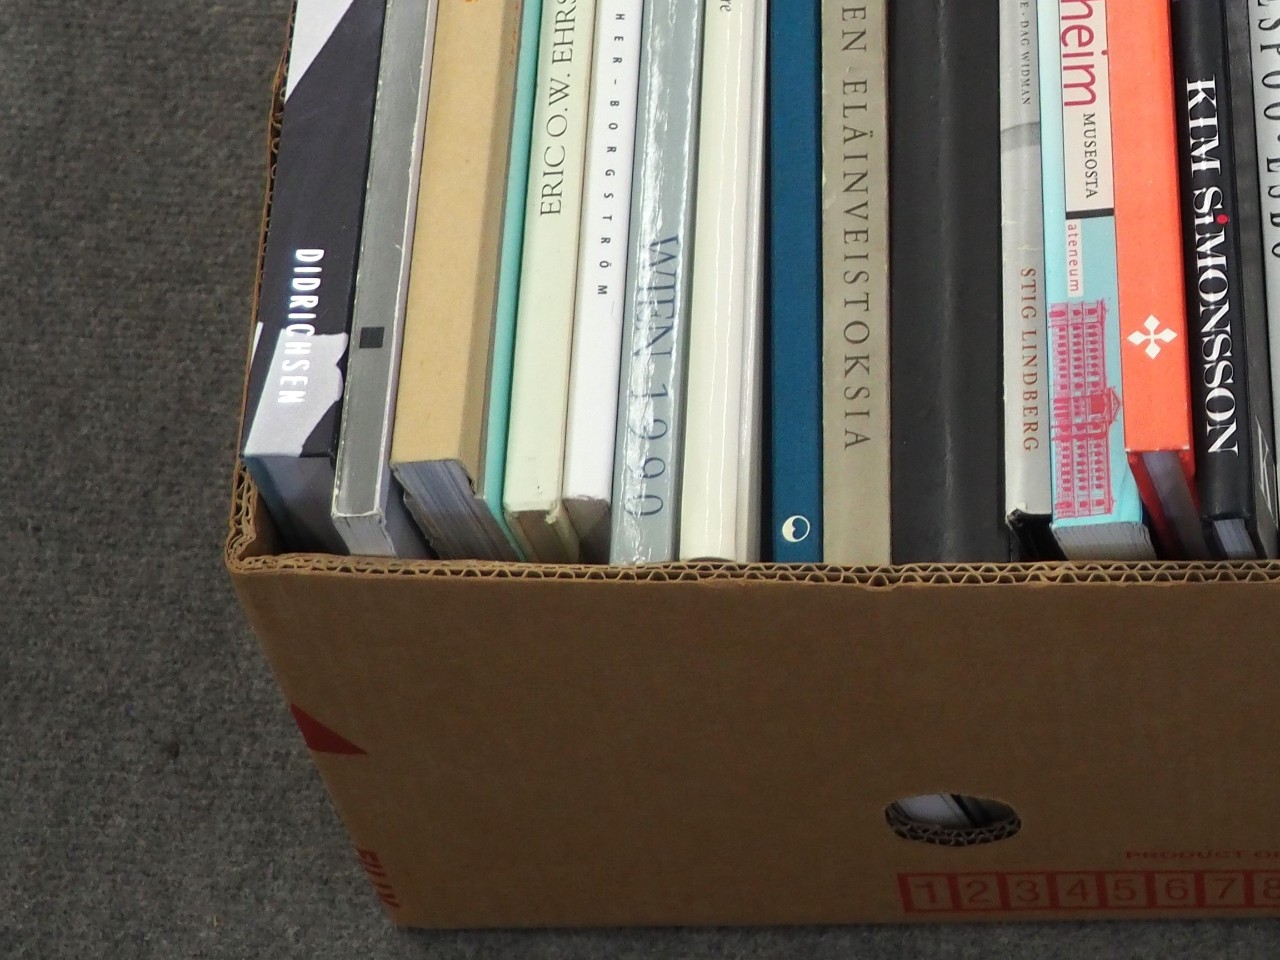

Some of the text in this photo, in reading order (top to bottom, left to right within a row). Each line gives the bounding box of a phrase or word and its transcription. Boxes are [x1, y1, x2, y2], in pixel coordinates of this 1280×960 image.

[1020, 20, 1030, 46] DAG
[1020, 50, 1031, 105] WIDMAN
[1083, 113, 1099, 199] MUSEOSTA
[1186, 74, 1221, 176] KIM
[540, 146, 567, 217] ERIC
[842, 78, 874, 450] ELÄINVEISTOKSIA
[1068, 223, 1080, 292] ateneum
[278, 248, 324, 404] DIDRICHSEN
[1020, 267, 1039, 451] STIG LINDBERG
[624, 234, 679, 517] WIEN 1900
[913, 881, 938, 904] 1
[965, 880, 991, 903] 2
[1016, 879, 1041, 902] 3
[1065, 879, 1089, 902] 4
[1113, 879, 1138, 901] 5
[1165, 879, 1189, 900] 6
[1213, 878, 1238, 900] 7
[1126, 850, 1243, 860] PRODUCT
